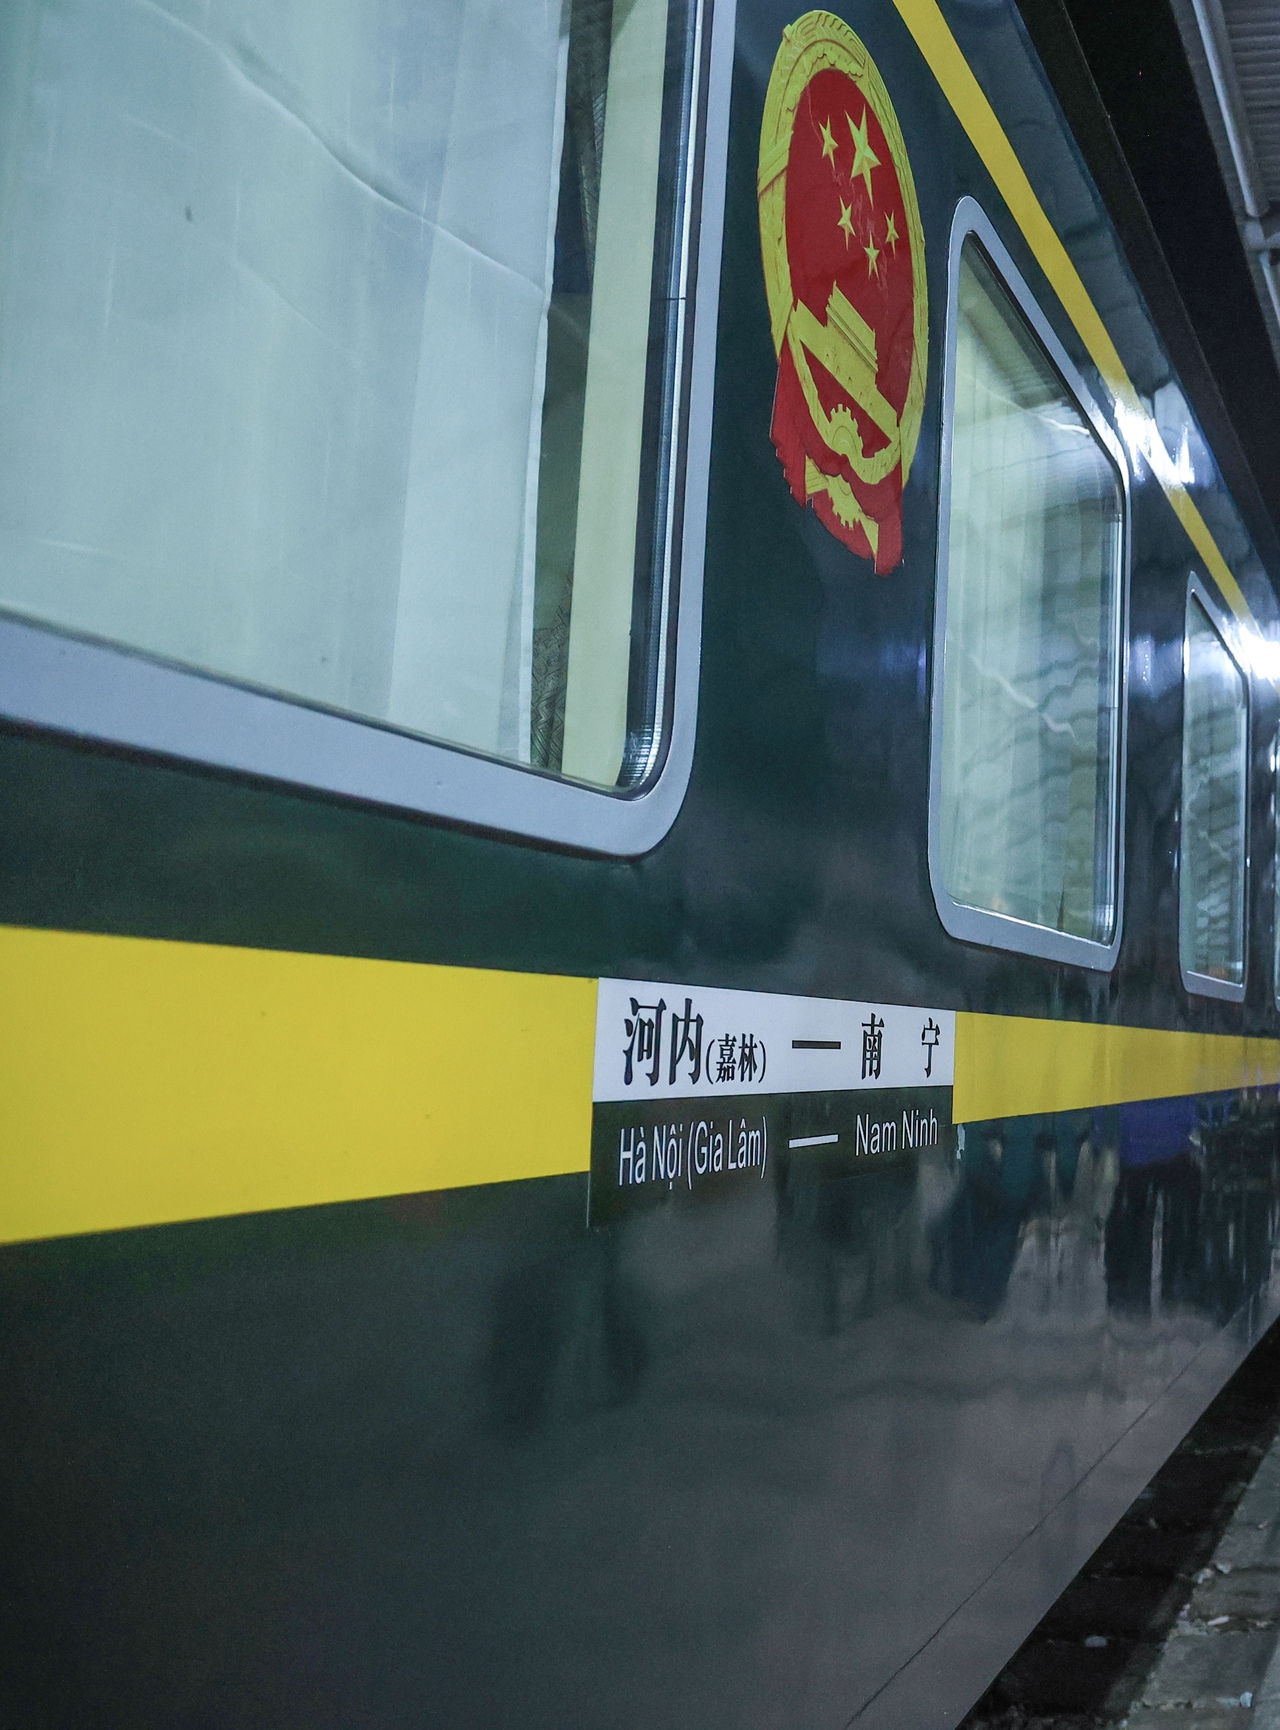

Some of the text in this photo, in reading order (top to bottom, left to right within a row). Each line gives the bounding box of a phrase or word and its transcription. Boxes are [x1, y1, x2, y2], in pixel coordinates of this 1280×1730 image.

[622, 997, 767, 1087] 河内(嘉林)
[618, 1108, 938, 1190] Hà Nội (Gia Lâm) Nam Ninh
